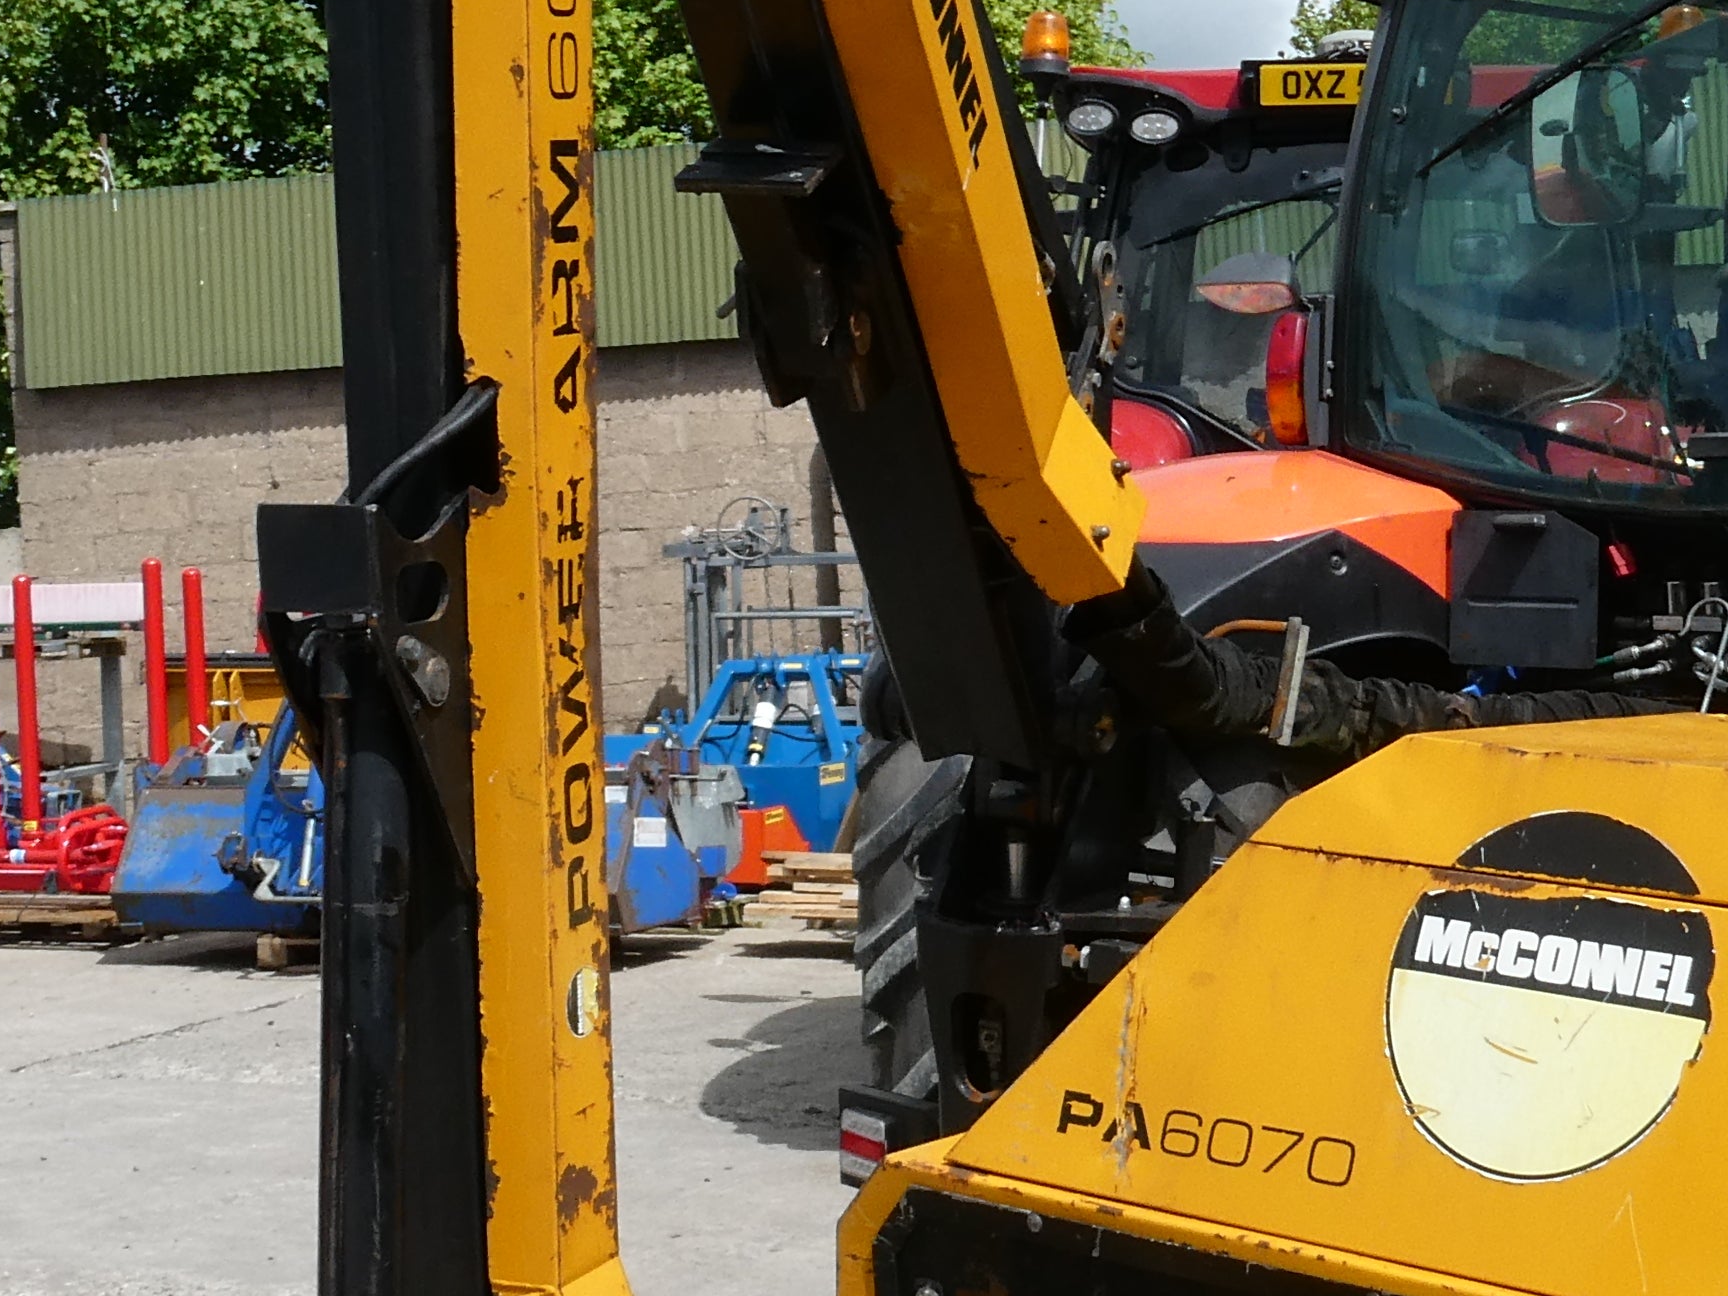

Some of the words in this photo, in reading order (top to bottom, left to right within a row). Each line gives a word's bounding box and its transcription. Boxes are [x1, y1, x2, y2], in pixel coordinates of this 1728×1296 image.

[1283, 70, 1346, 99] OXZ
[549, 139, 582, 415] ARM
[557, 475, 597, 932] POWER
[1414, 914, 1695, 1006] McCONNEL
[1056, 1089, 1356, 1187] PA6070
